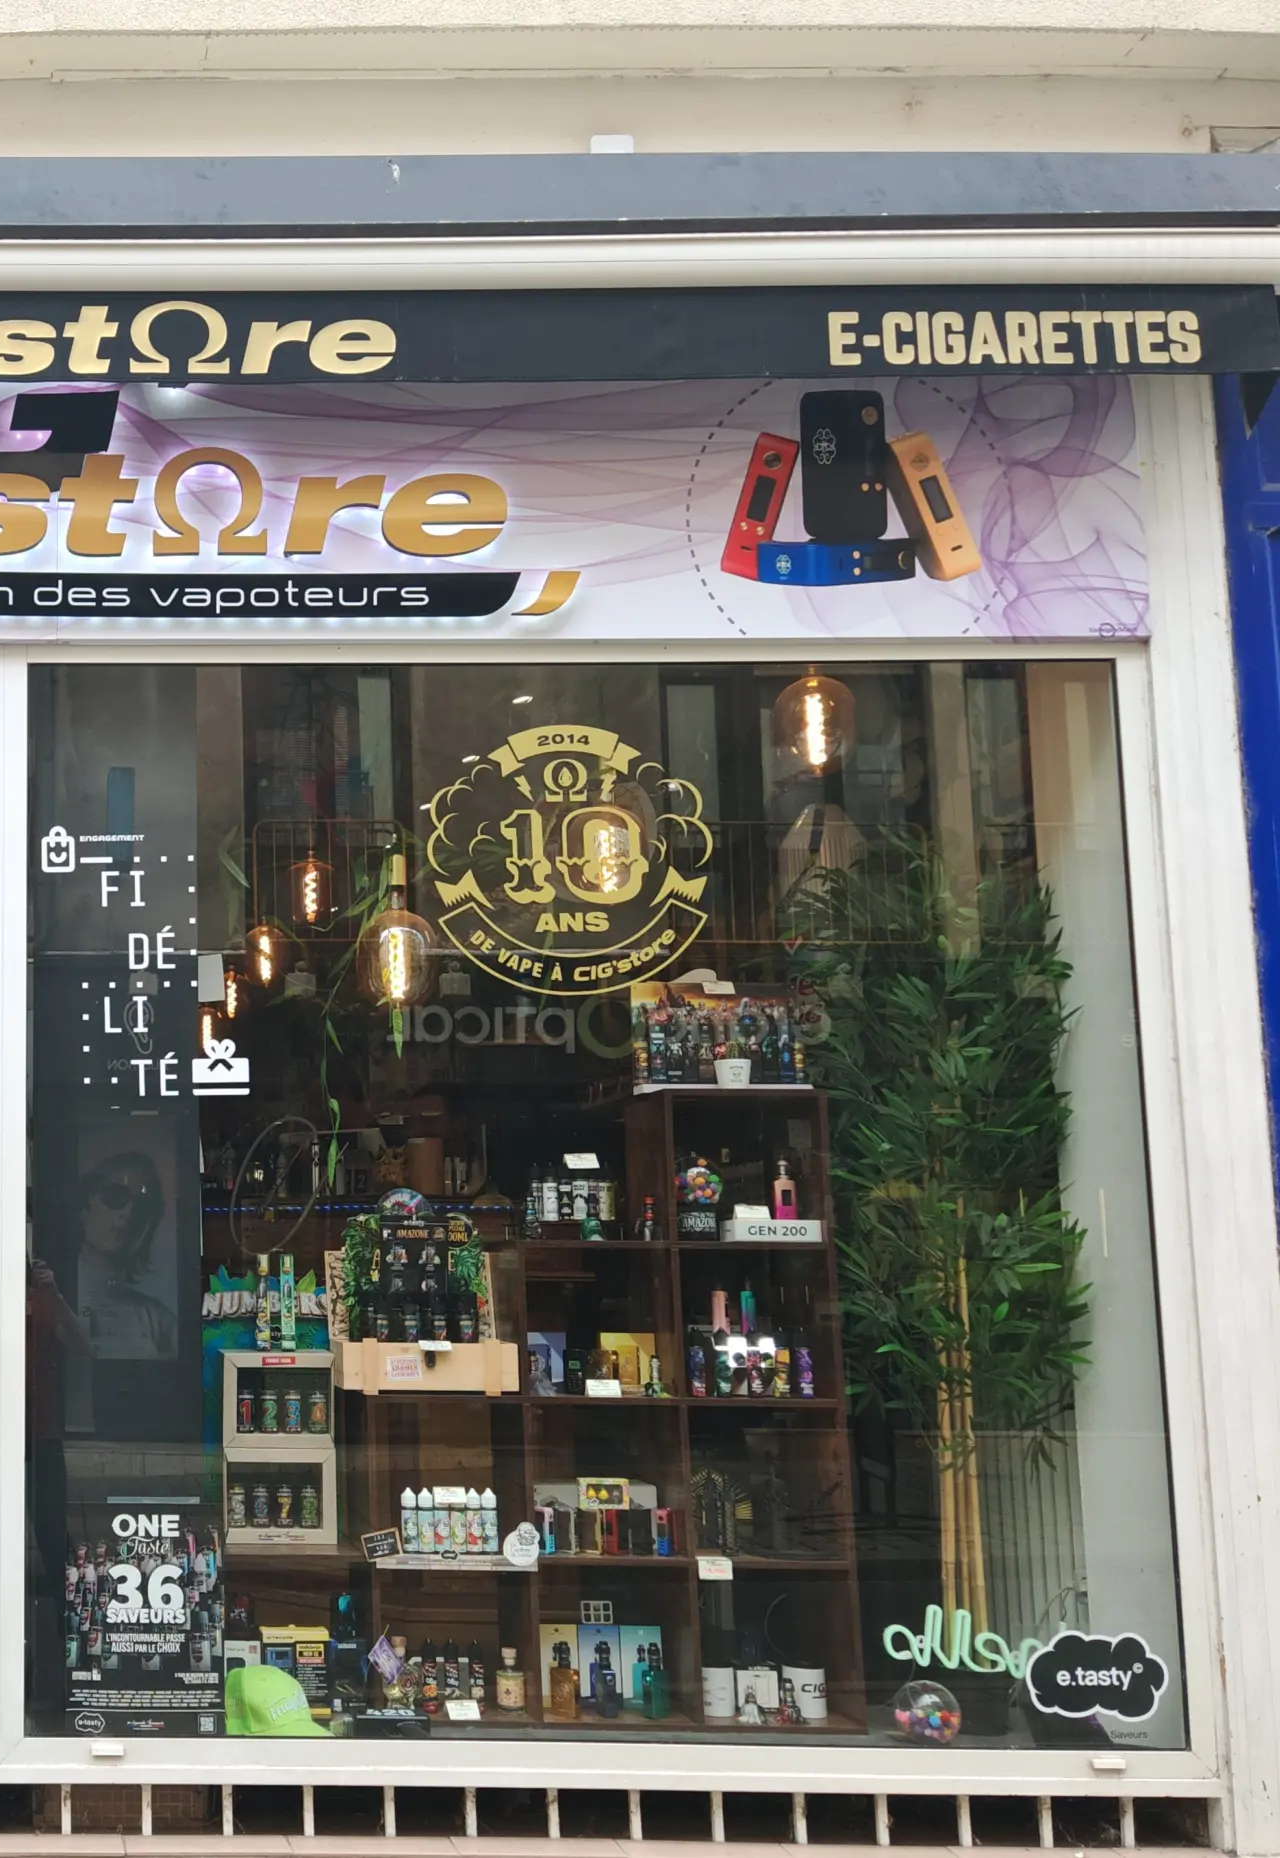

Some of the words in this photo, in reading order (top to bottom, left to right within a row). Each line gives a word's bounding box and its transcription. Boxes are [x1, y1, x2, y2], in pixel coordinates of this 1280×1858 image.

[827, 310, 1203, 367] E-CIGARETTES
[33, 579, 131, 607] des
[150, 583, 429, 614] vapoteurs
[537, 734, 590, 746] 2014
[79, 834, 145, 842] ENGAGEMENT
[499, 806, 650, 905] 10
[101, 870, 146, 907] FI
[535, 911, 610, 933] ANS
[128, 925, 176, 970] DÉ
[470, 929, 496, 953] DE
[497, 947, 544, 978] VAPE
[550, 961, 563, 981] À
[104, 995, 148, 1033] LI
[130, 1052, 179, 1097] TÉ
[748, 1225, 777, 1236] GEN
[782, 1226, 808, 1236] 200
[239, 1400, 252, 1426] 1
[262, 1400, 277, 1426] 2
[286, 1400, 301, 1426] 3
[311, 1402, 326, 1423] 4
[278, 1496, 292, 1519] 7
[111, 1514, 180, 1538] ONE
[120, 1536, 170, 1558] Taste
[107, 1564, 185, 1610] 36
[106, 1608, 186, 1624] SAVEURS
[106, 1633, 165, 1643] L'INCONTOURNABLE
[166, 1633, 185, 1643] PASSE
[111, 1642, 134, 1653] AUSSI
[134, 1644, 148, 1653] PAR
[148, 1644, 156, 1653] LE
[157, 1642, 180, 1653] CHOIX
[1110, 1729, 1148, 1739] Saveurs
